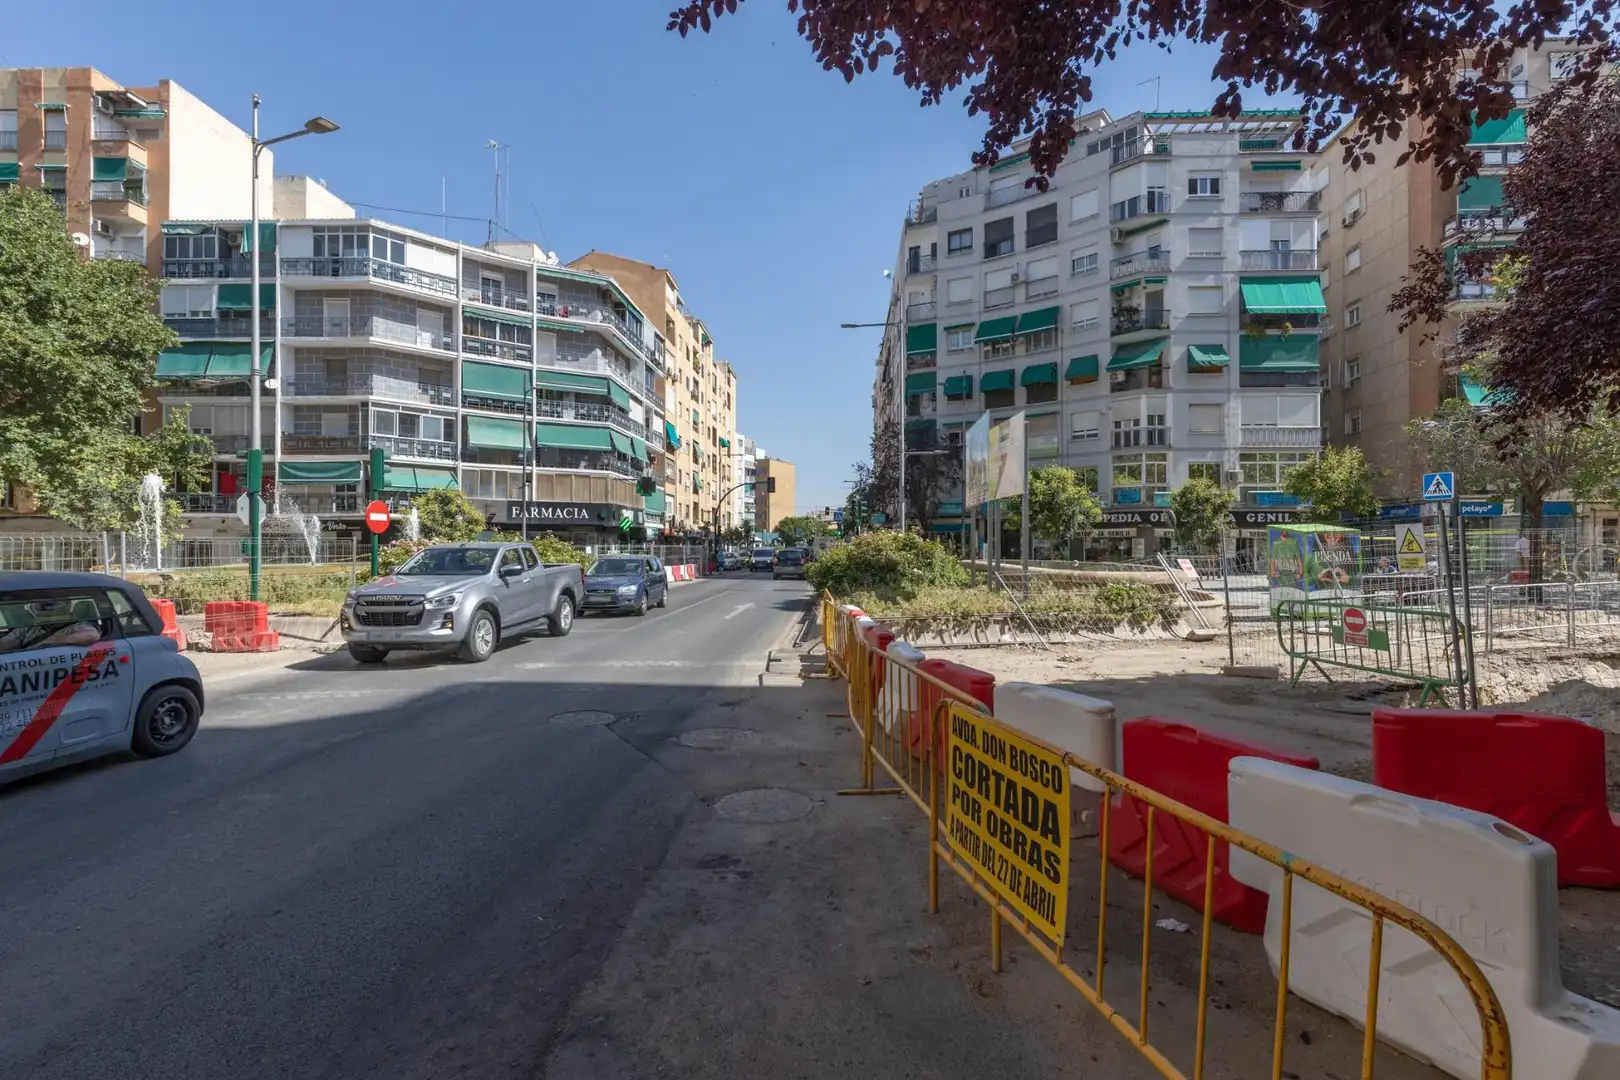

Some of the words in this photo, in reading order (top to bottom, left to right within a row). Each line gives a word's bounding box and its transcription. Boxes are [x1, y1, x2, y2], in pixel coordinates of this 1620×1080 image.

[512, 506, 589, 519] FARMACIA
[1246, 513, 1292, 522] GENIL
[1462, 505, 1488, 514] pelayo
[49, 655, 67, 665] DE
[71, 647, 117, 662] PLAGAS
[952, 714, 980, 750] AVDA.
[982, 728, 1007, 766] DON
[1009, 743, 1063, 795] BOSCO
[952, 744, 1061, 848] CORTADA
[952, 782, 982, 827] POR
[986, 809, 1061, 885] OBRAS
[950, 814, 955, 838] A
[955, 817, 981, 862] PARTIR
[981, 844, 996, 877] DEL
[999, 853, 1009, 886] 27
[1009, 866, 1022, 900] DE
[1023, 876, 1056, 928] ABRIL
